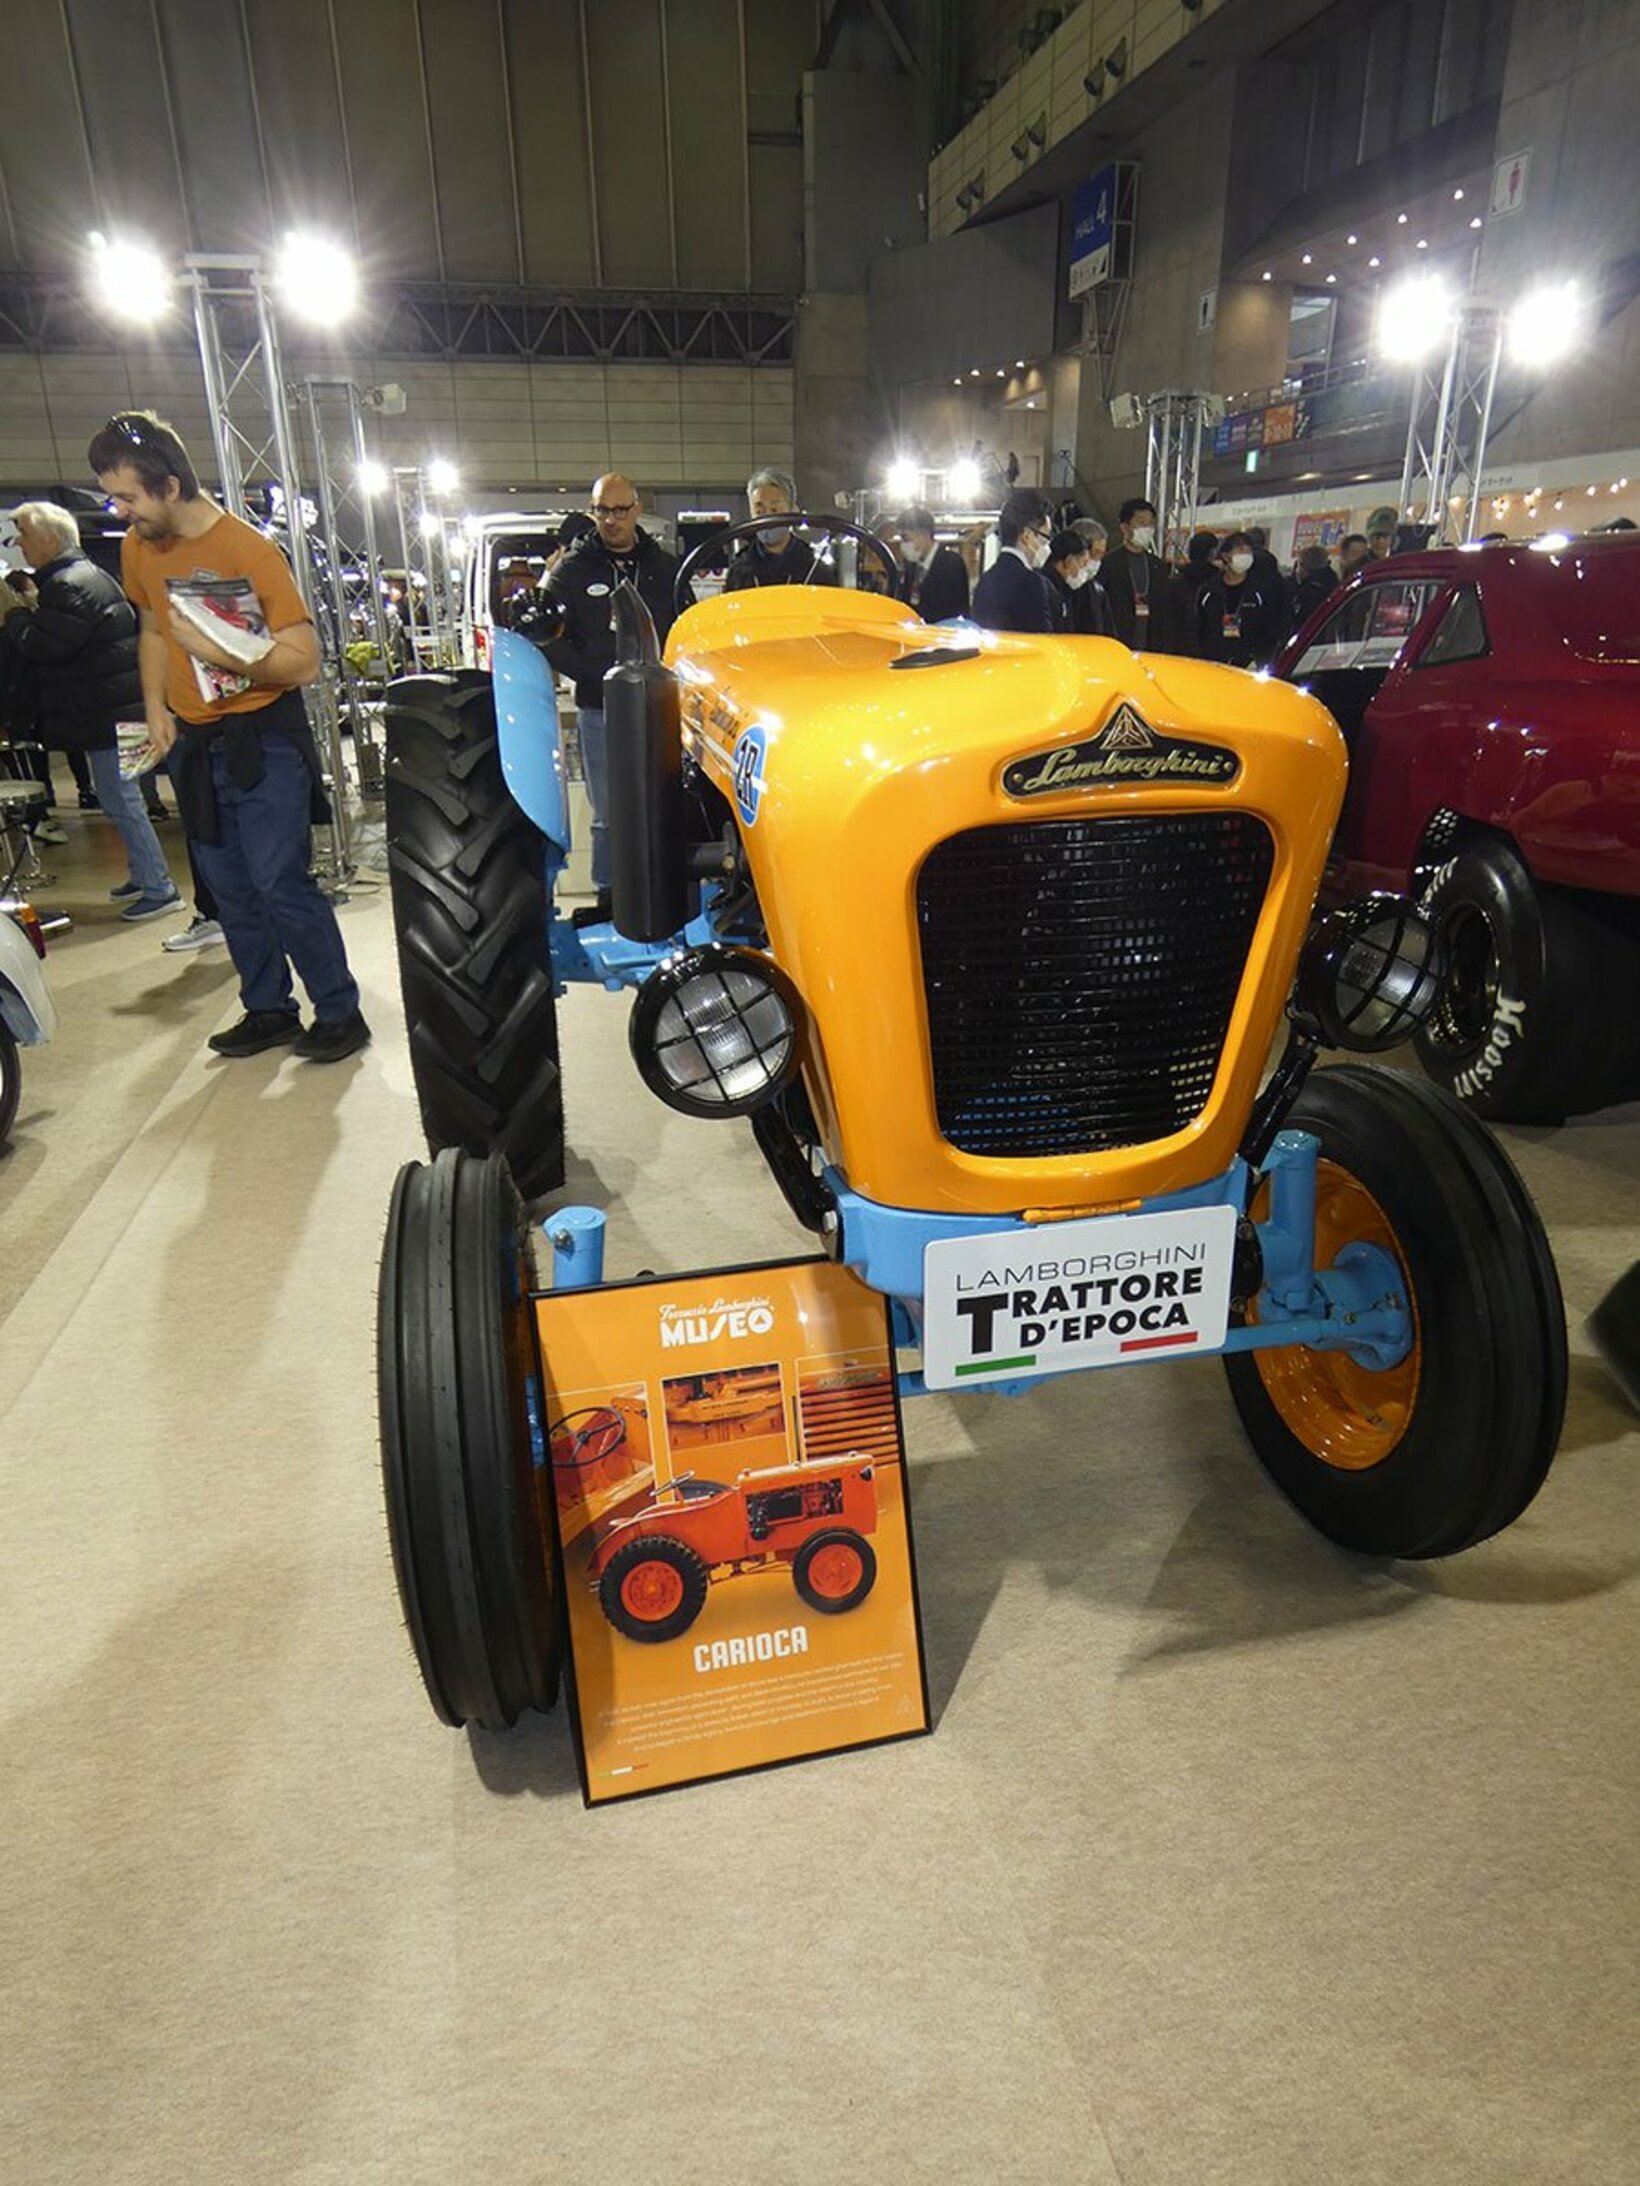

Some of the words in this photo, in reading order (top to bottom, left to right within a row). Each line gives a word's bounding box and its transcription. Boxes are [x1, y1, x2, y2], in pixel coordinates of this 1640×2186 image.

[1096, 189, 1107, 224] 4
[1023, 749, 1221, 790] Lamborghini
[956, 1243, 1206, 1292] LAMBORGHINI
[660, 1307, 774, 1348] MUSEO
[956, 1266, 1204, 1355] TRATTORE
[1020, 1302, 1190, 1349] D'EPOCA
[692, 1625, 809, 1673] CARIOCA
